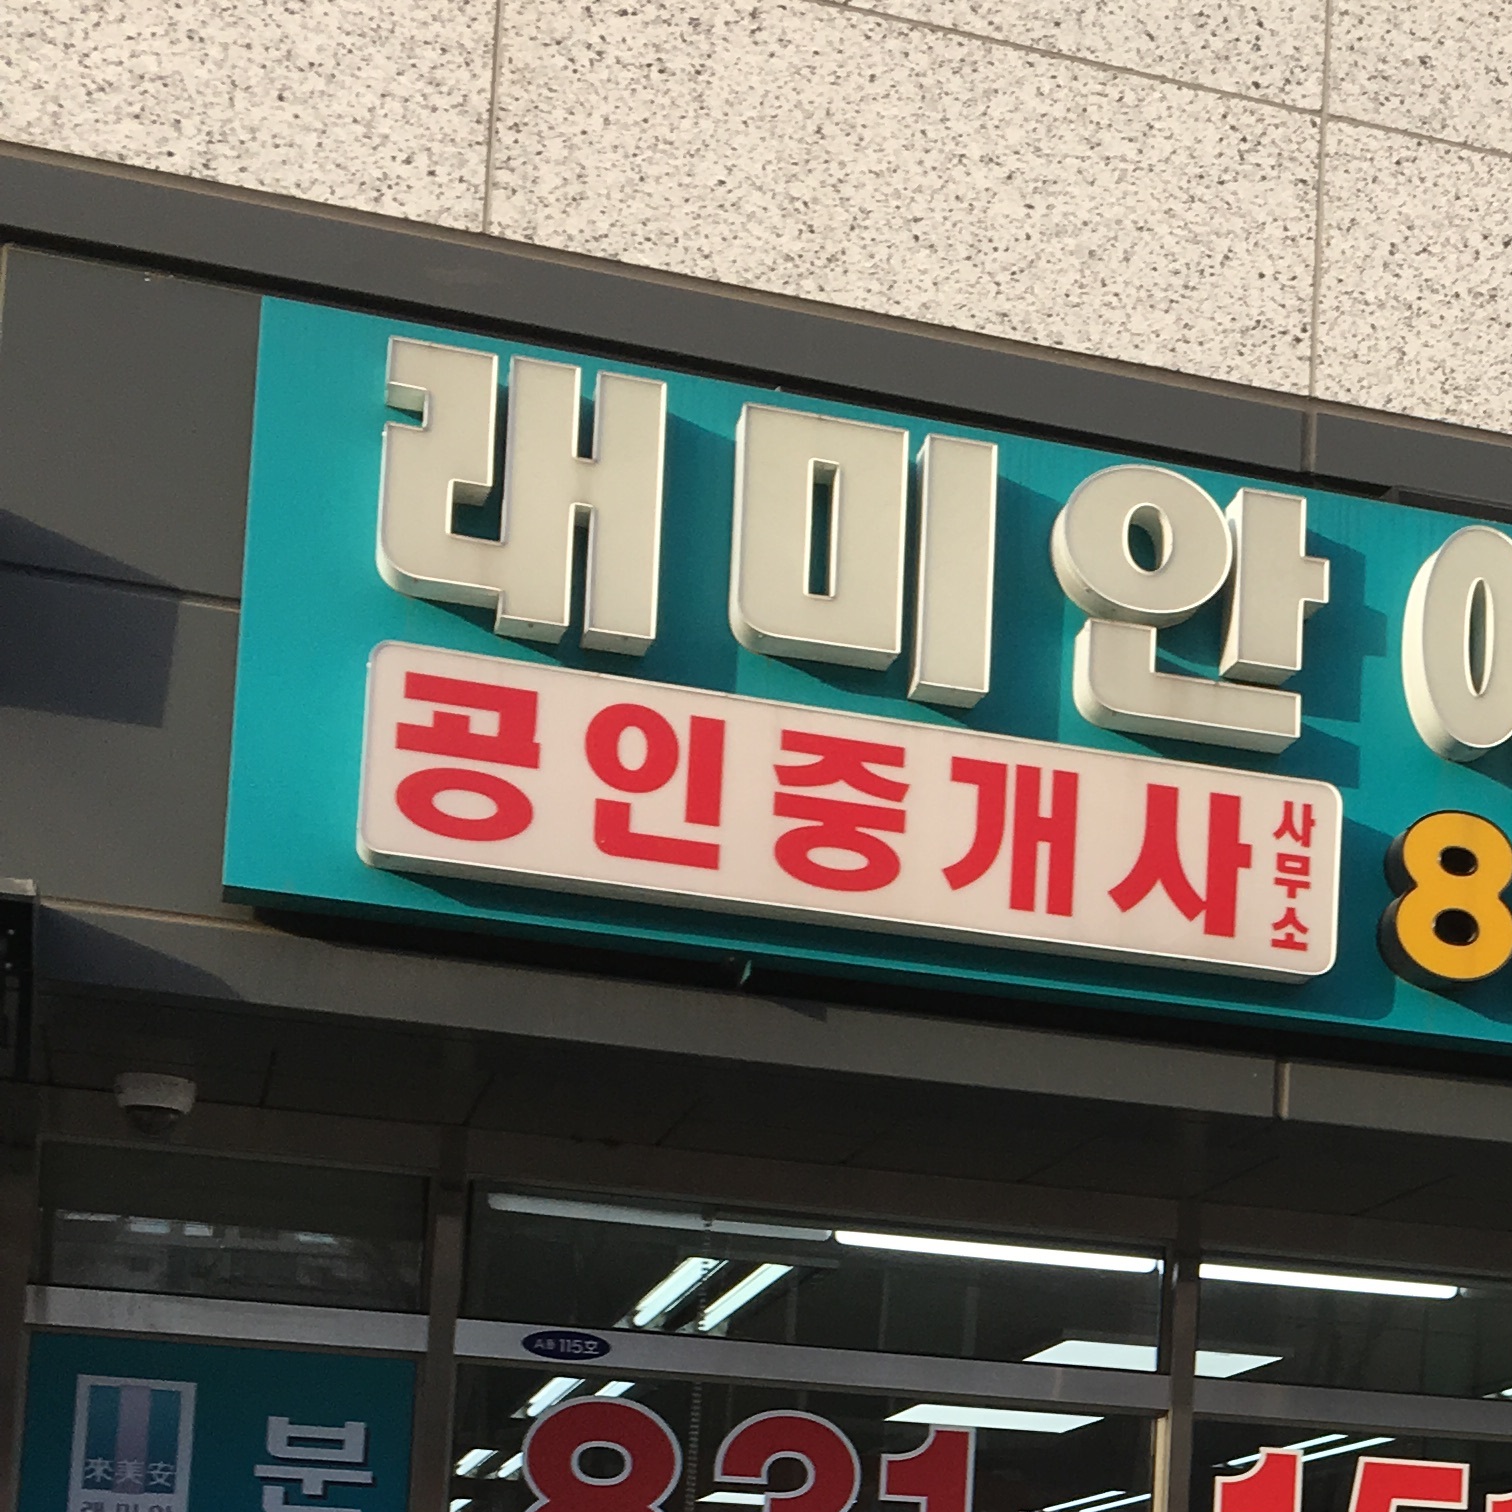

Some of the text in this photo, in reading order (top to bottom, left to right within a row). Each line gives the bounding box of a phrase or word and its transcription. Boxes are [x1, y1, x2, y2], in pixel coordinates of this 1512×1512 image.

[377, 336, 1330, 751] 래미안
[394, 670, 1253, 939] 공인중개사
[1271, 800, 1317, 952] 사무소
[559, 1338, 600, 1355] 115호
